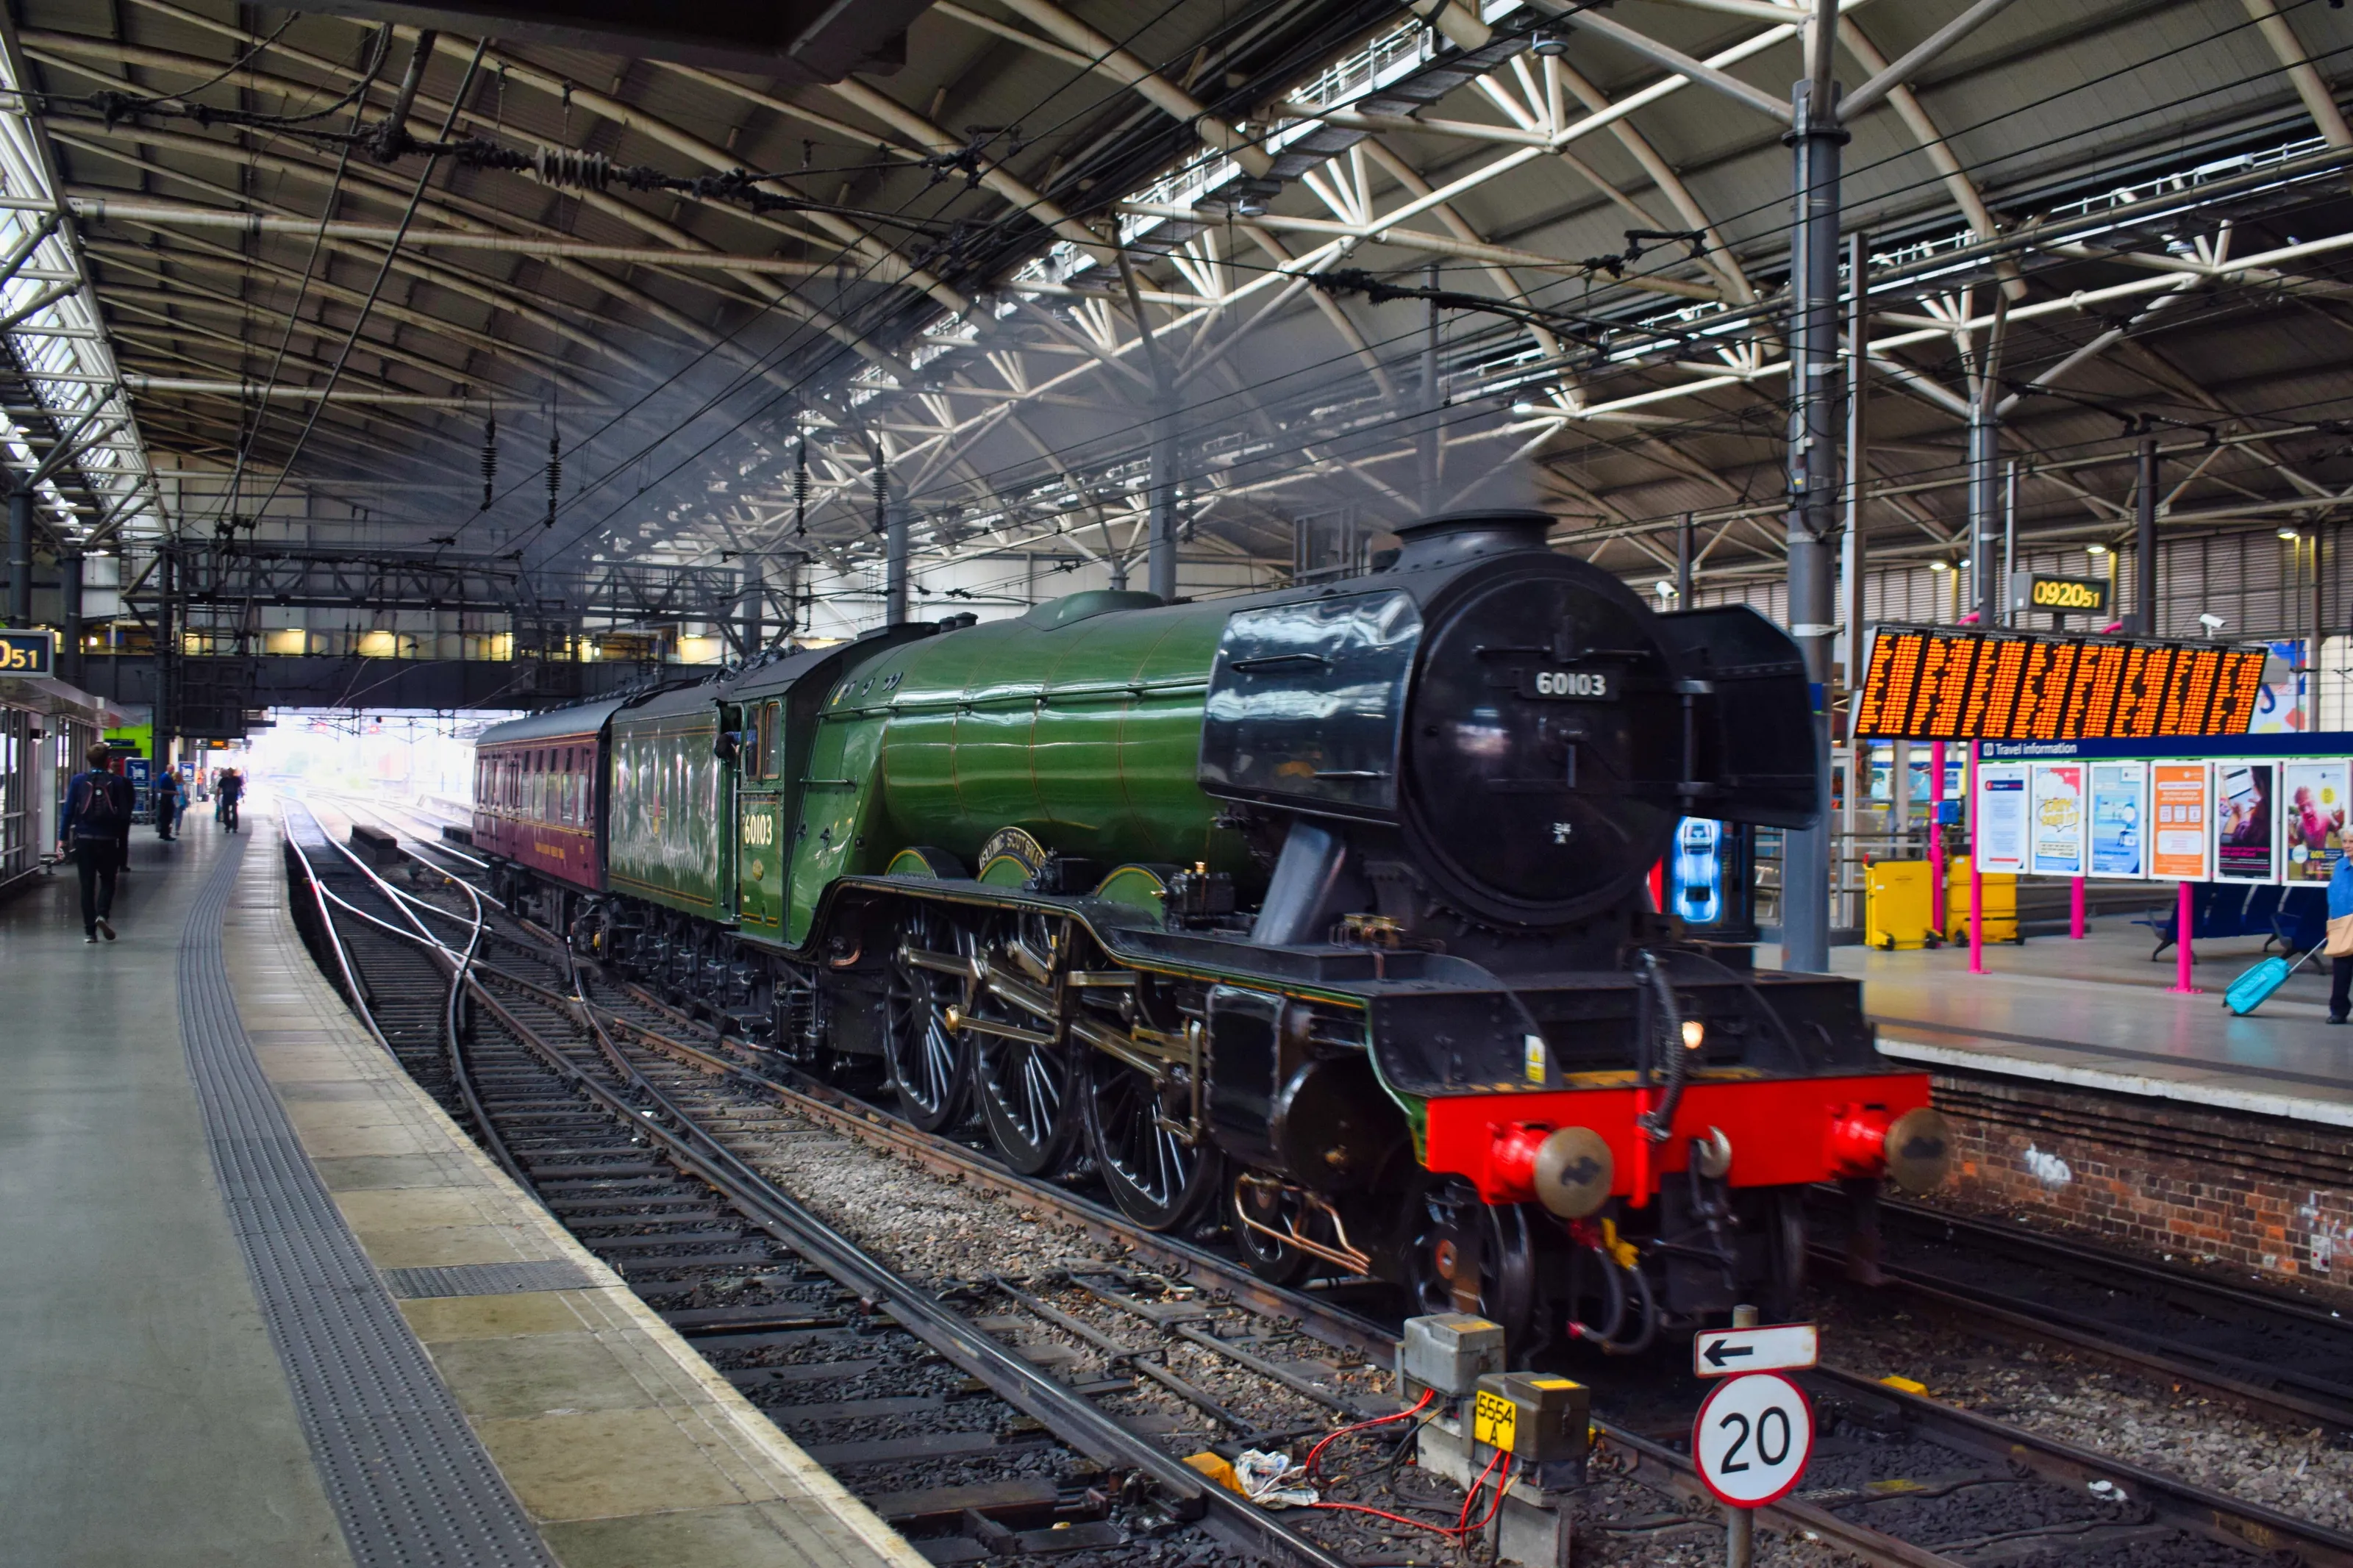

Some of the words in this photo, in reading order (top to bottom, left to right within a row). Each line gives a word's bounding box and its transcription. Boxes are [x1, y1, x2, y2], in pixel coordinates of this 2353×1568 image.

[1536, 672, 1606, 695] 60103
[1995, 742, 2021, 755] Travel
[2023, 742, 2077, 754] information
[745, 814, 773, 845] 60103
[1478, 1395, 1513, 1428] 5554
[1489, 1422, 1498, 1447] A
[1719, 1406, 1790, 1474] 20
